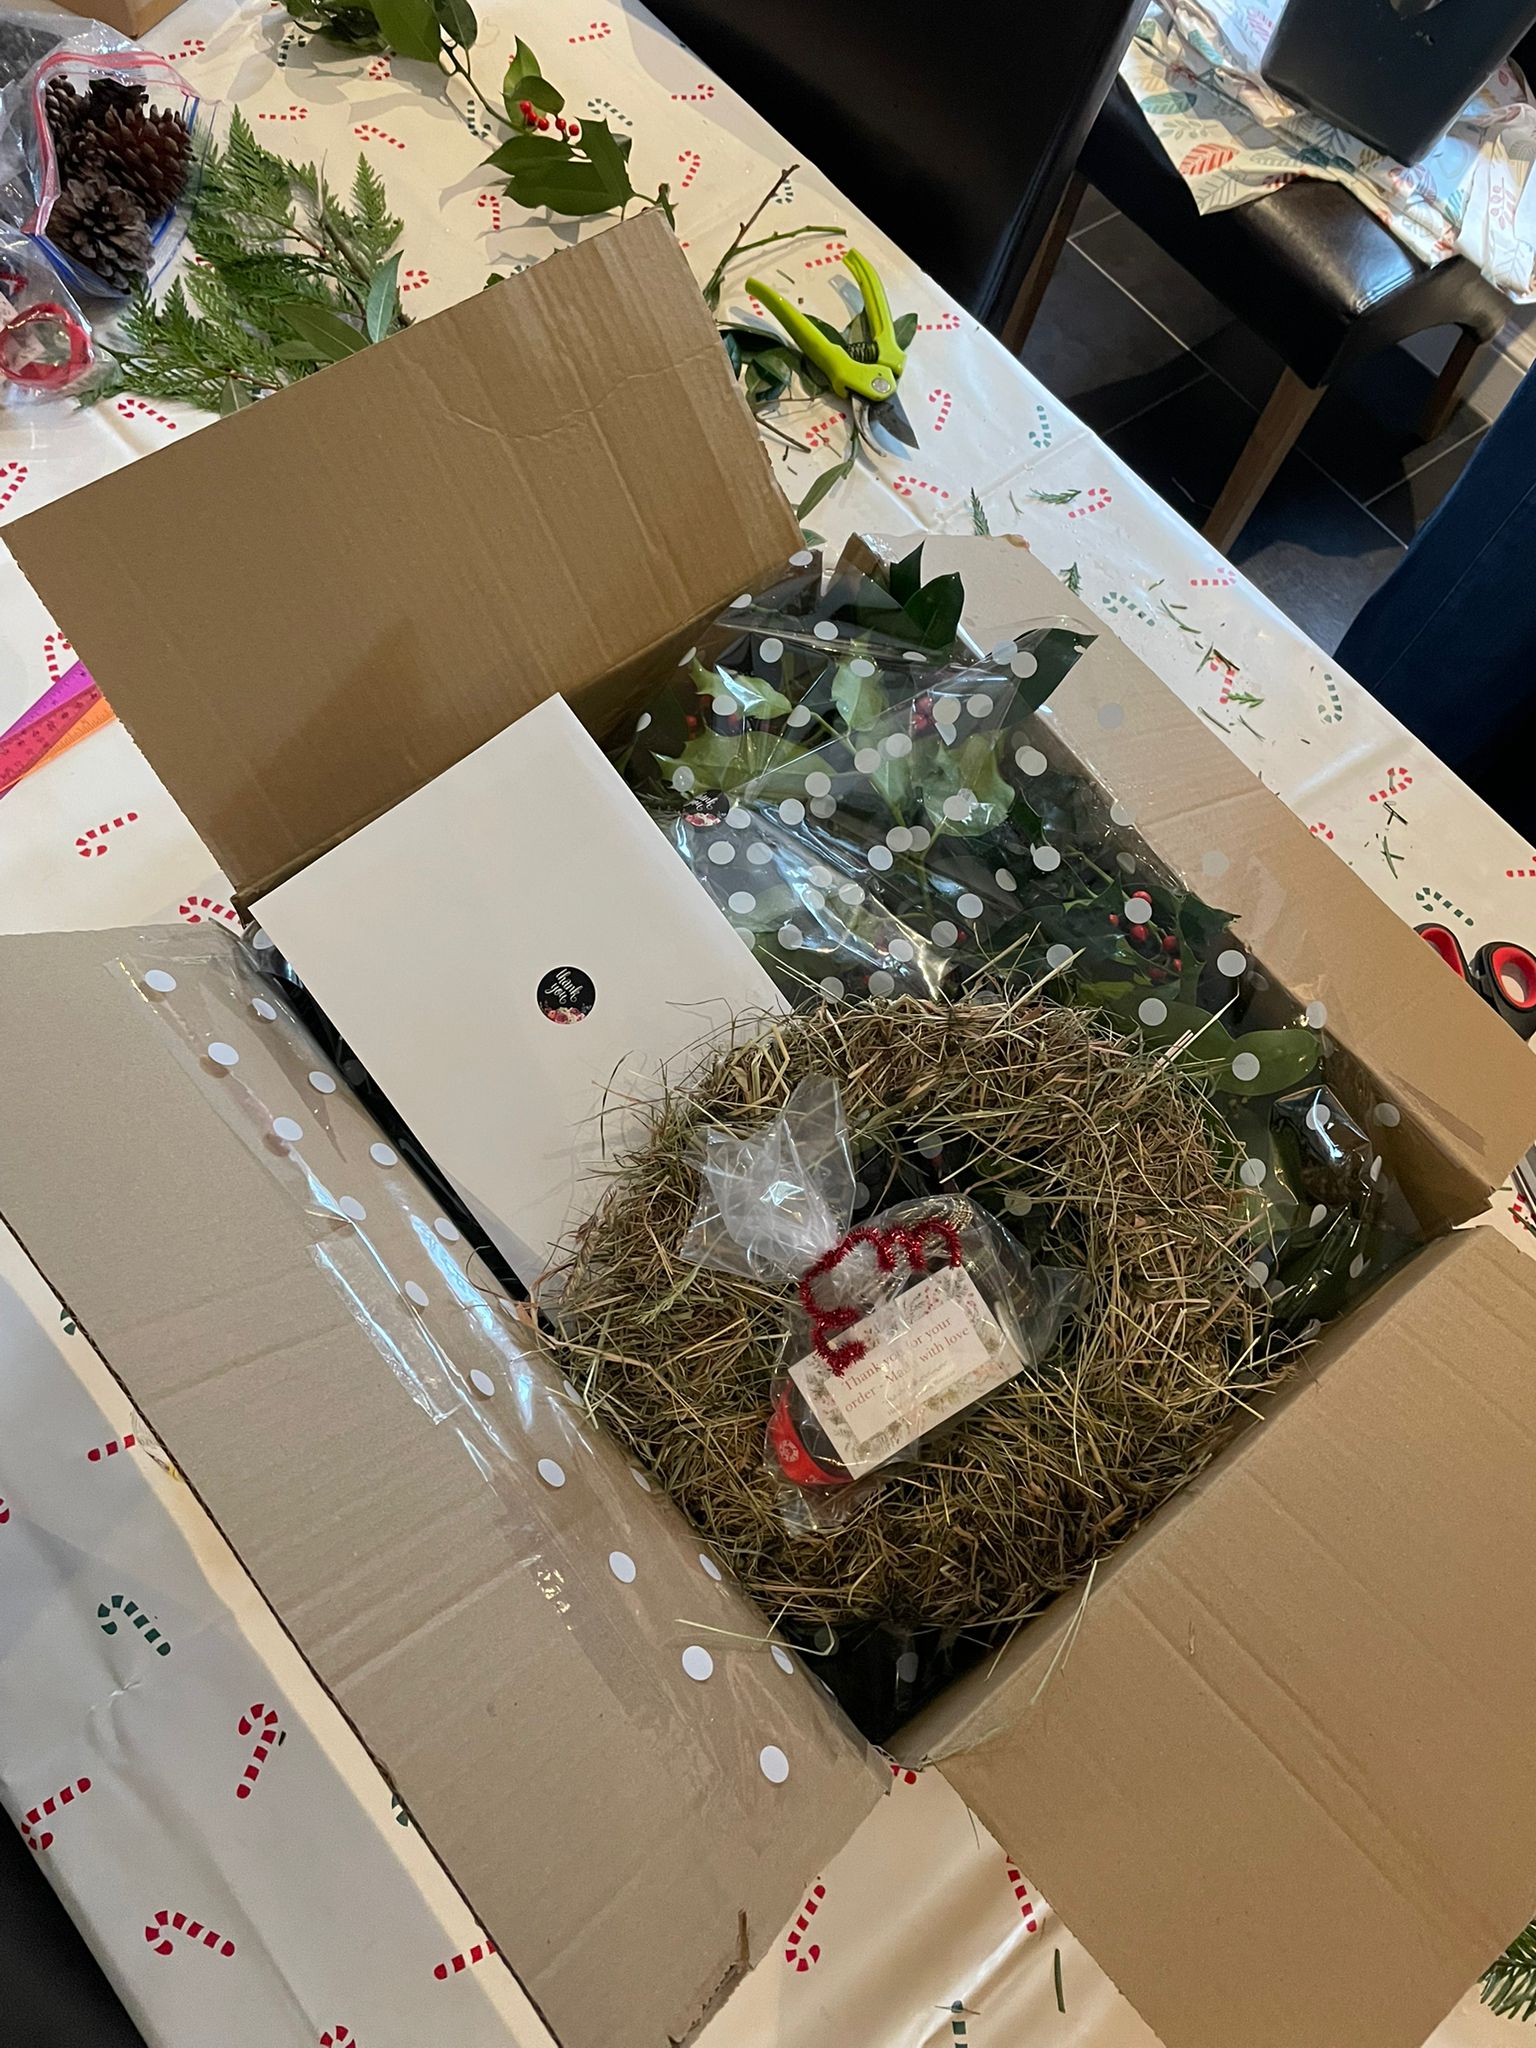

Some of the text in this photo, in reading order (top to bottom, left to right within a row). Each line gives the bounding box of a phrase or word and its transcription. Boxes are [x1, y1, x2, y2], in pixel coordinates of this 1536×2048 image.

[544, 982, 567, 1005] you
[555, 968, 584, 1003] thank
[841, 1362, 882, 1390] Thank
[926, 1317, 951, 1338] your
[845, 1387, 876, 1412] order
[885, 1359, 914, 1384] Ma
[919, 1343, 945, 1362] with
[944, 1327, 970, 1346] love
